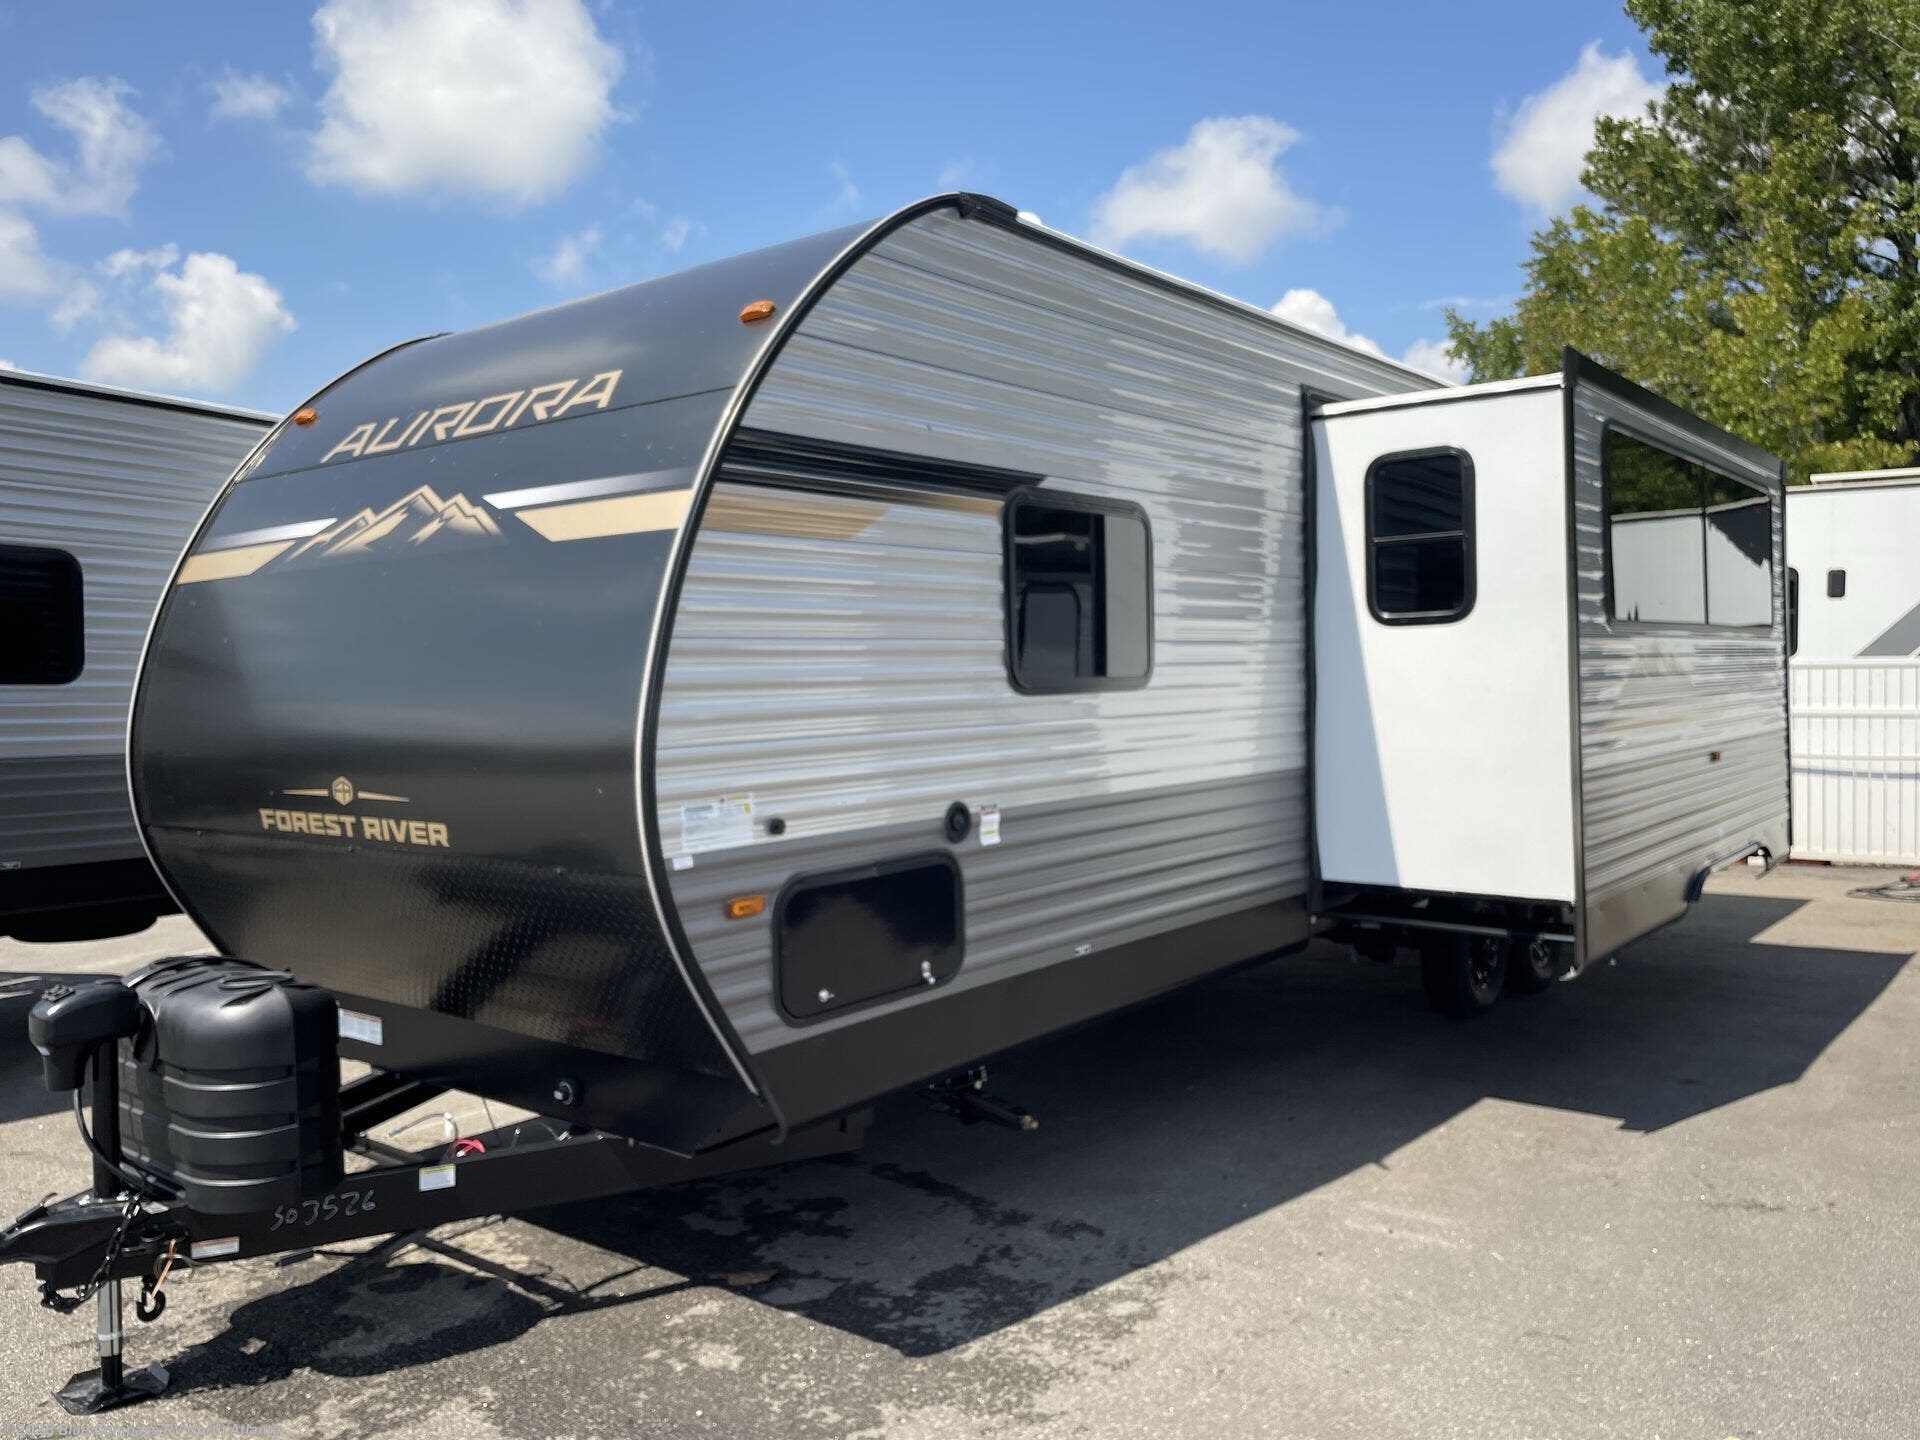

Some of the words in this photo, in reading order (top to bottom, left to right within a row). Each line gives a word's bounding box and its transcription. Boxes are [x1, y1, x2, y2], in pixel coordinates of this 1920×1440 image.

[320, 369, 623, 463] AURORA
[259, 808, 356, 839] FOREST
[361, 816, 451, 848] RIVER
